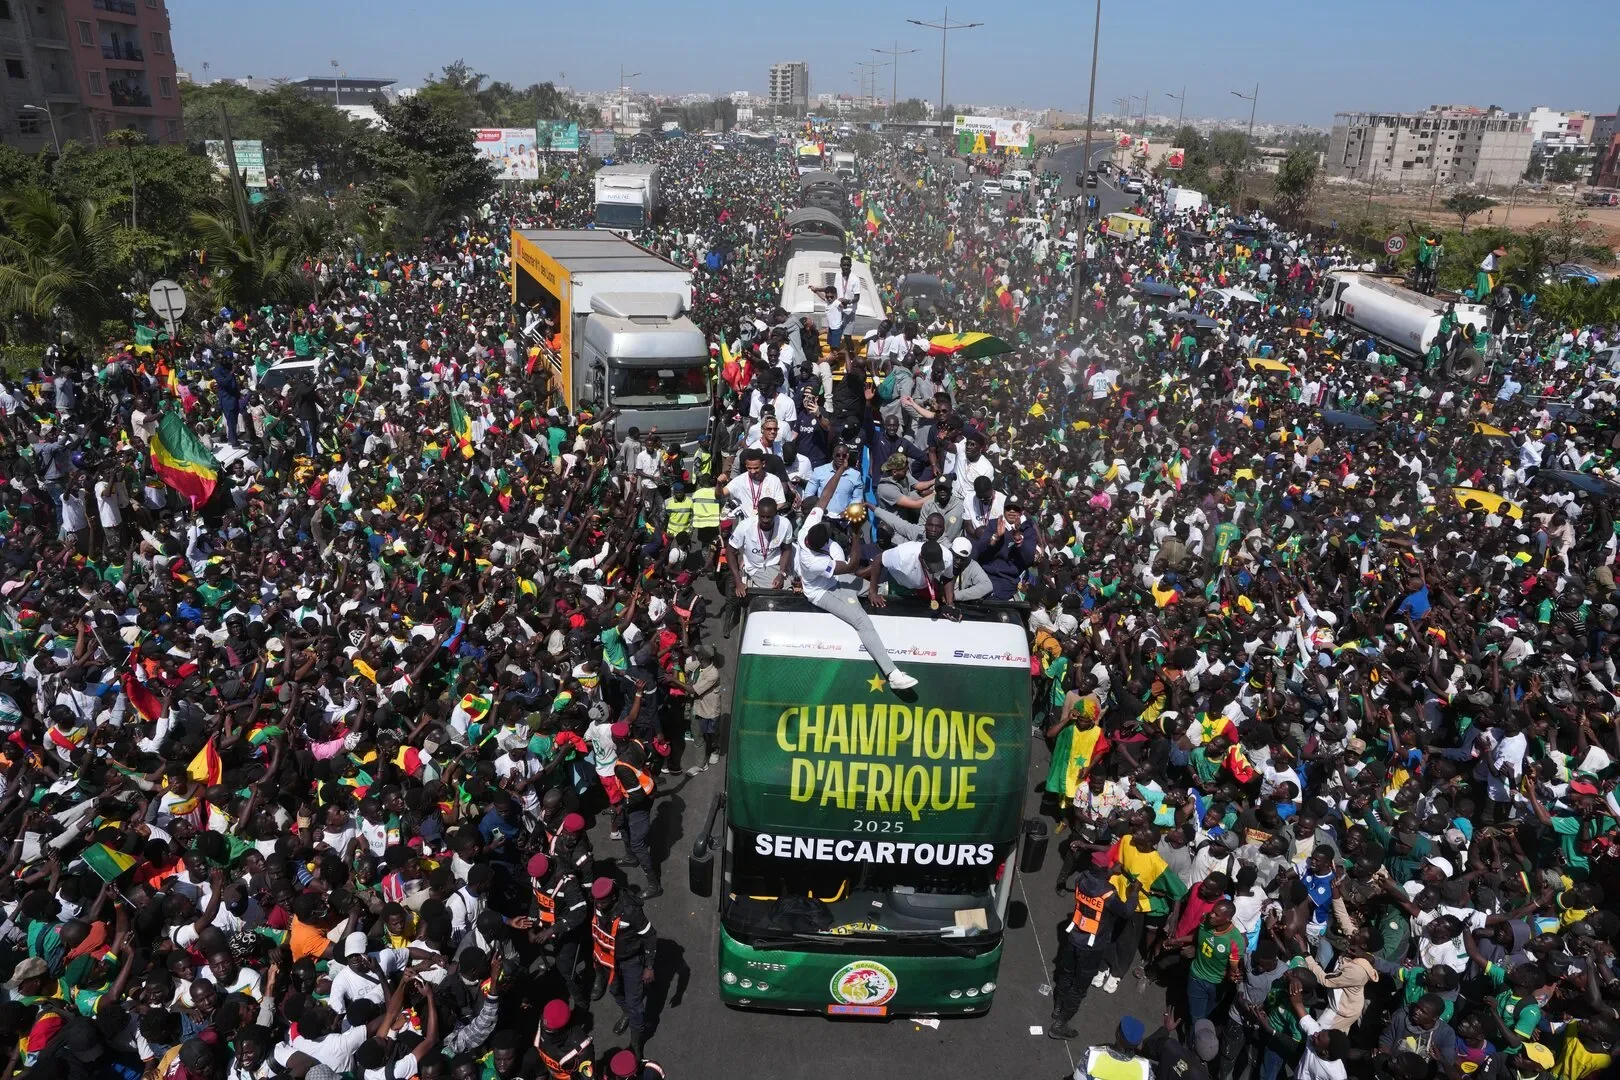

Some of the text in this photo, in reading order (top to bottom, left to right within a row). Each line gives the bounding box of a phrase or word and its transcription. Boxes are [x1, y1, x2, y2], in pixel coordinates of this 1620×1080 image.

[1389, 239, 1402, 249] 90
[953, 649, 1027, 663] SENECARTOURS
[776, 704, 996, 761] CHAMPIONS
[790, 758, 977, 821] D'AFRIQUE
[853, 820, 904, 833] 2025
[755, 833, 994, 865] SENECARTOURS
[1077, 889, 1102, 908] POLICE
[1202, 941, 1214, 959] 13
[747, 961, 787, 971] HIGER
